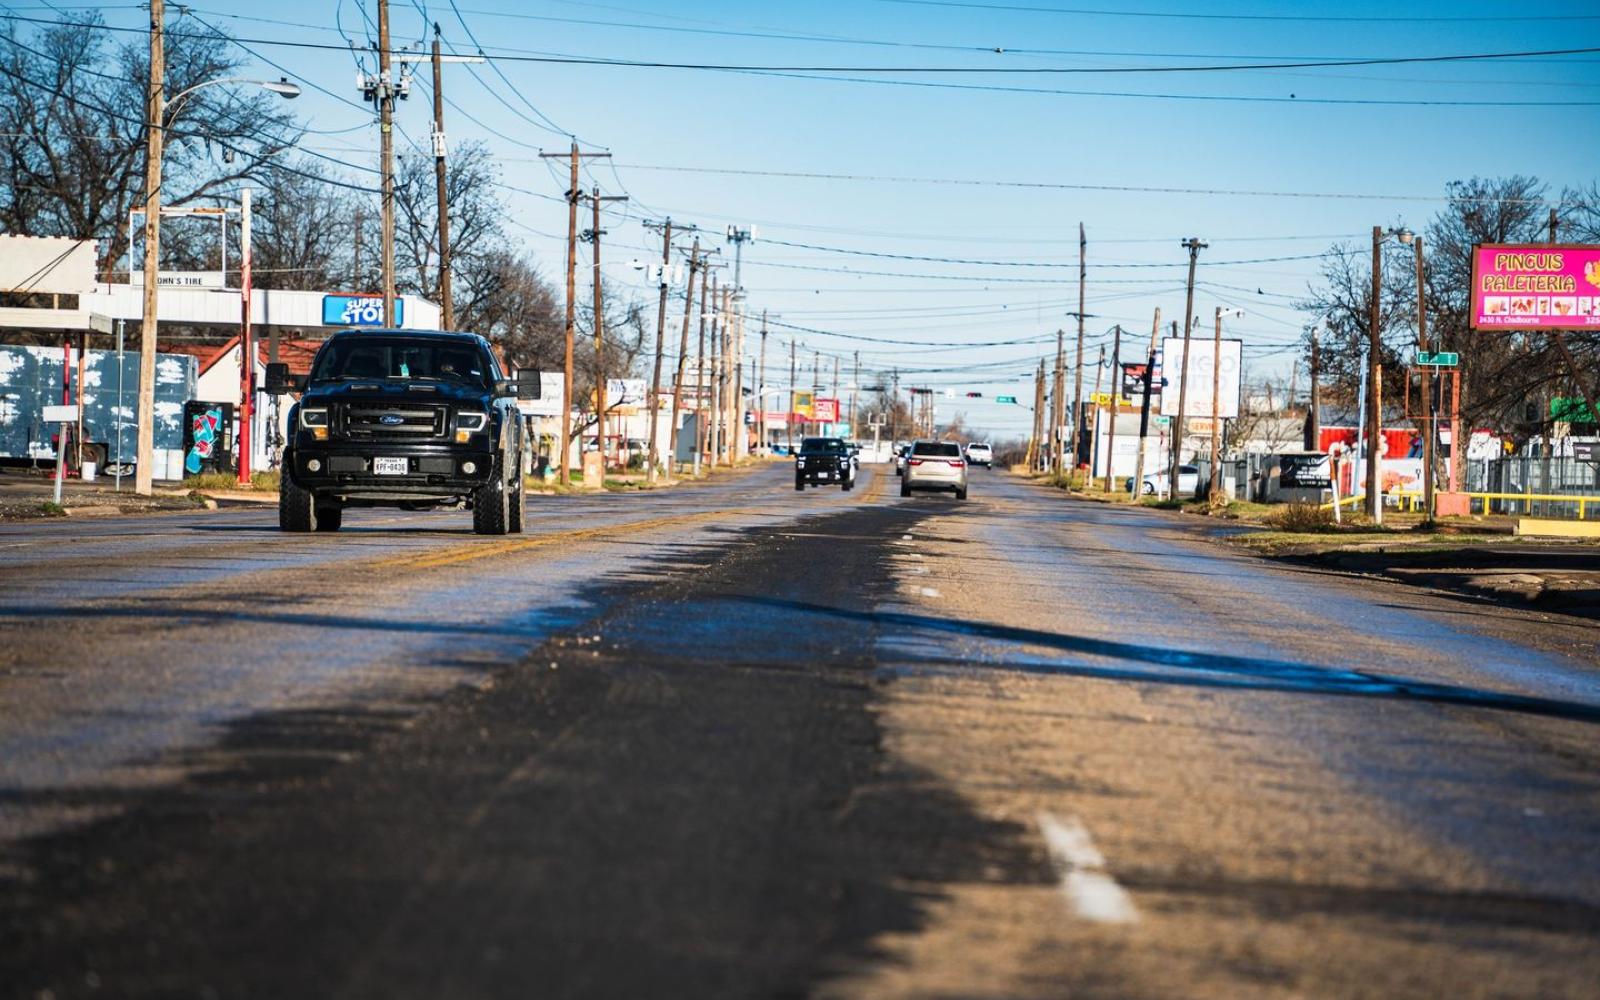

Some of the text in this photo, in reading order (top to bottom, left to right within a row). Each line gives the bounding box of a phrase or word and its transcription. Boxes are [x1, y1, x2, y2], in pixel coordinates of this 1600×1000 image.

[1495, 253, 1564, 272] PINGUIS
[185, 277, 203, 286] TIRE
[1482, 274, 1577, 293] PALETERIA
[346, 298, 384, 311] SUPER
